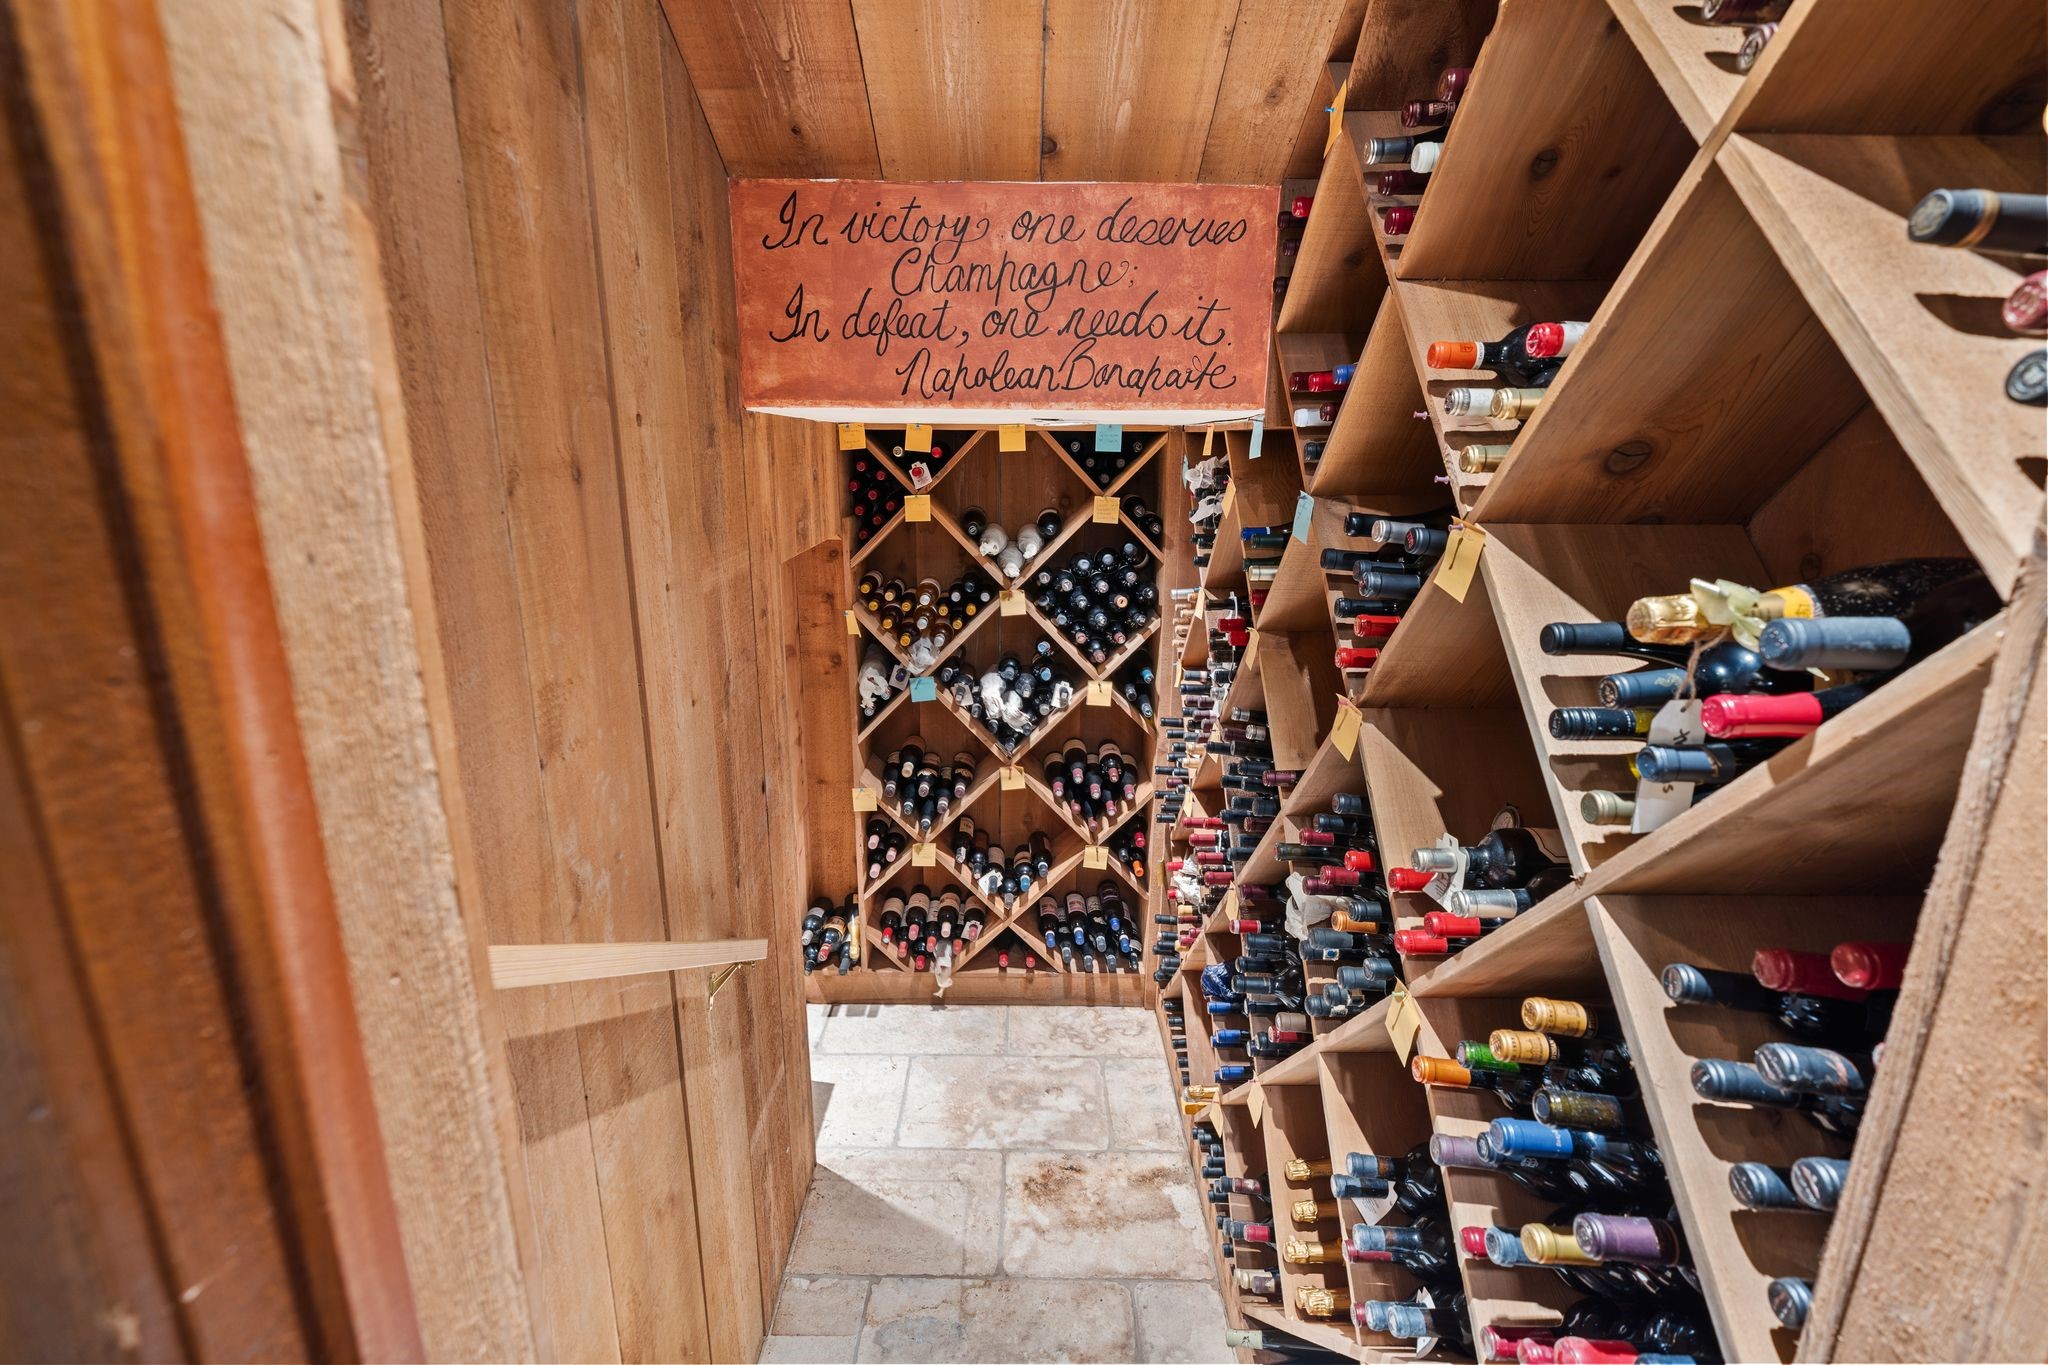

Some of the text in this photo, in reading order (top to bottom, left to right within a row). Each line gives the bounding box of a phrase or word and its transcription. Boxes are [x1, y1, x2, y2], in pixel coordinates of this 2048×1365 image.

[762, 189, 1248, 265] In victory one deserves
[769, 283, 1232, 357] In defeat, one needs it.
[895, 337, 1237, 401] Napolean Bonaparte
